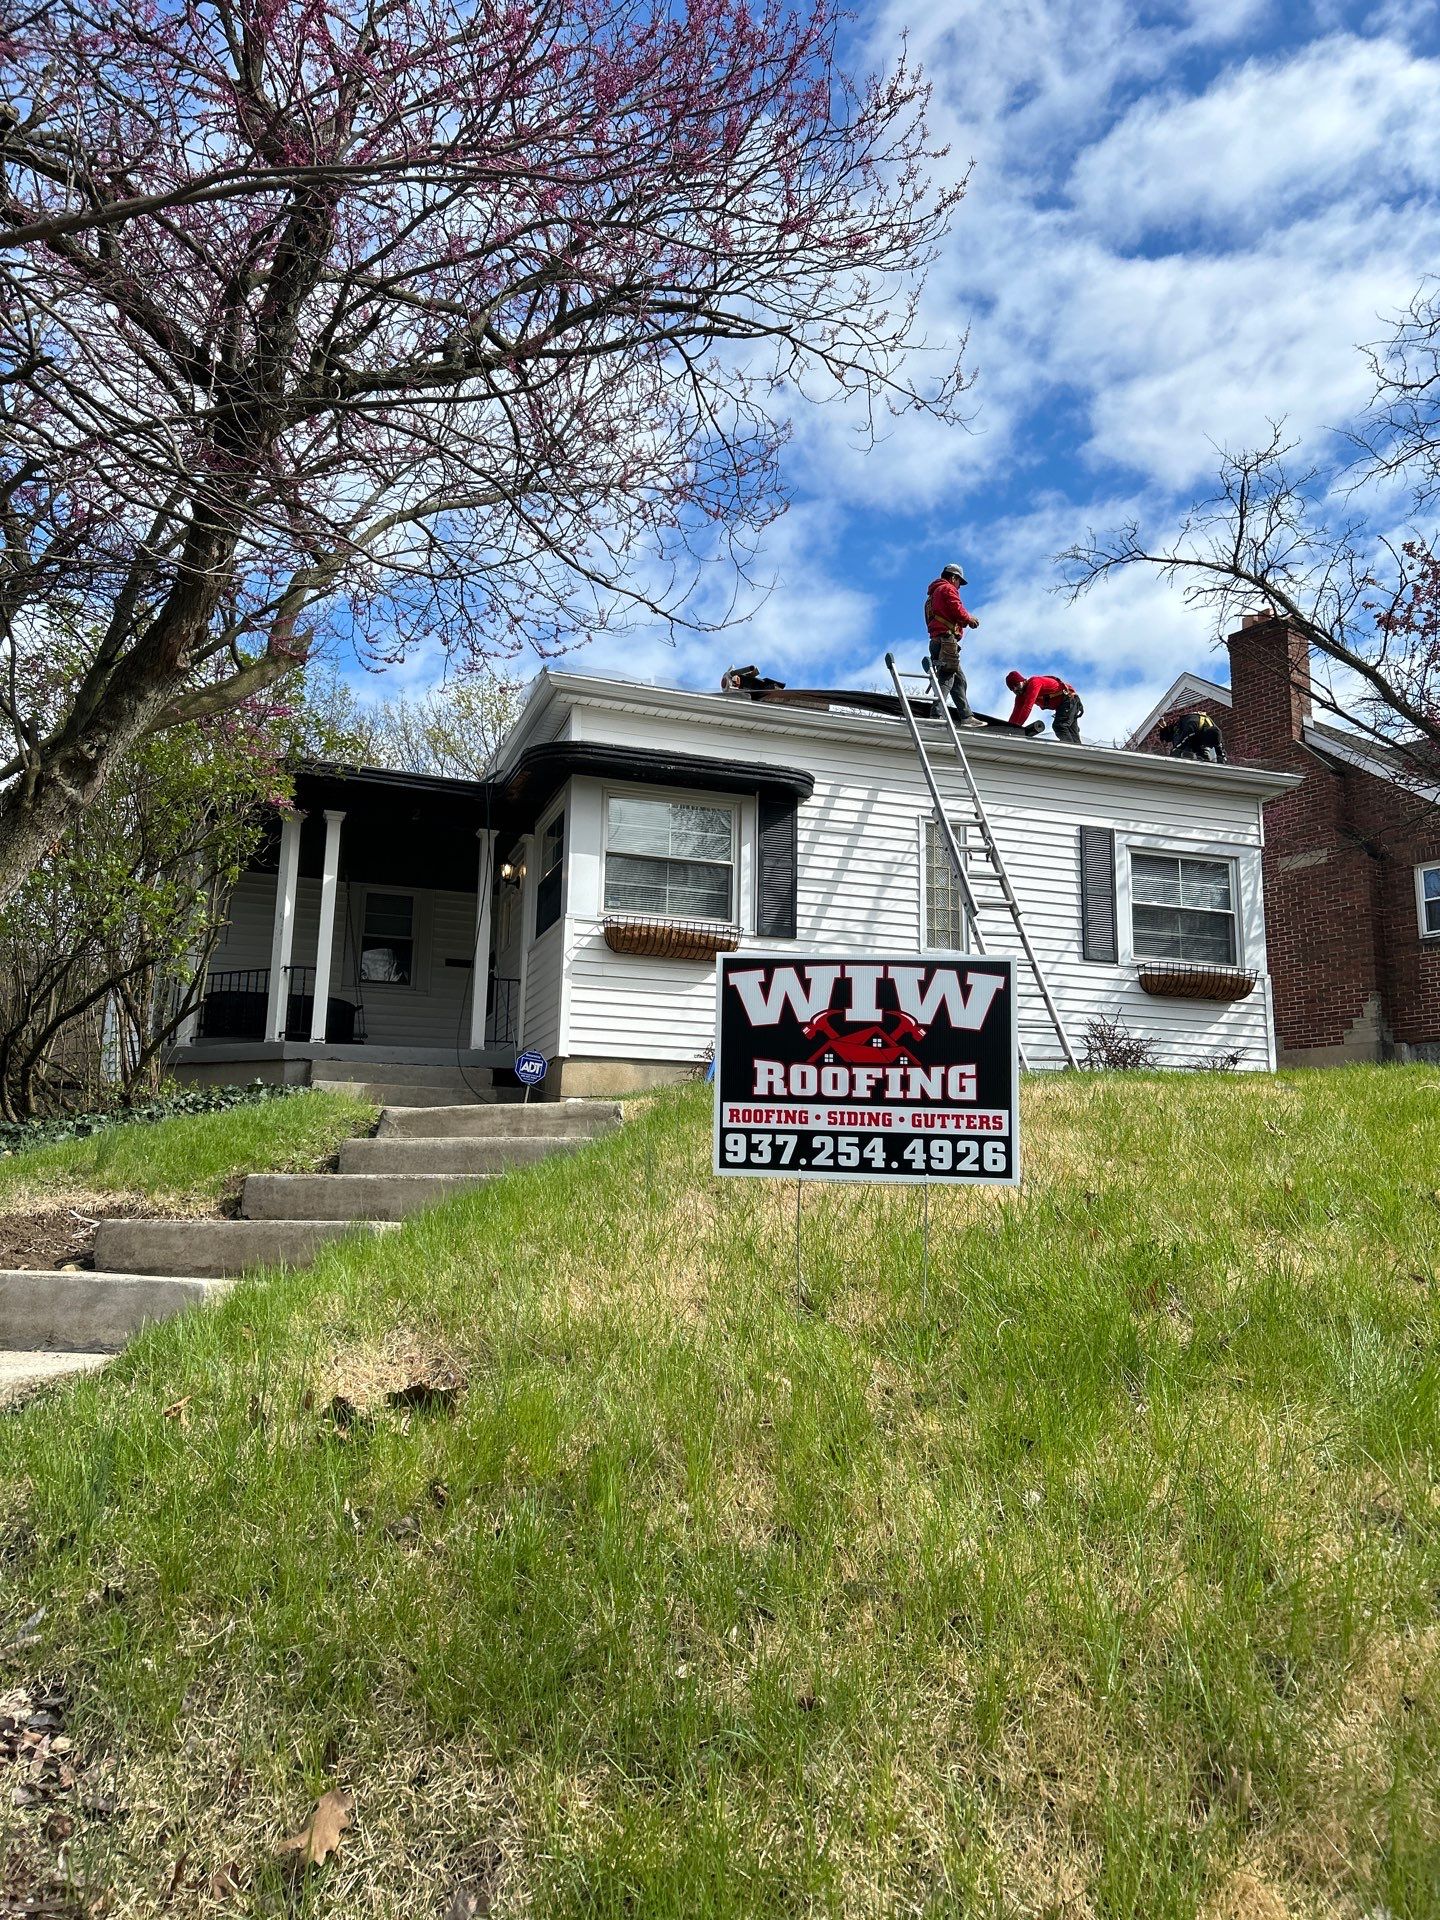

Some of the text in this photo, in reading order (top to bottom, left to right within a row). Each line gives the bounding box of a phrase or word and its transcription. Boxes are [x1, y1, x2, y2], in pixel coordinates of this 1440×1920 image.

[727, 964, 1005, 1031] WIW
[520, 1061, 542, 1074] ADT
[752, 1058, 978, 1101] ROOFING
[728, 1107, 1003, 1130] ROOFING SIDING GUTTERS
[725, 1132, 1007, 1172] 937.254.4926
